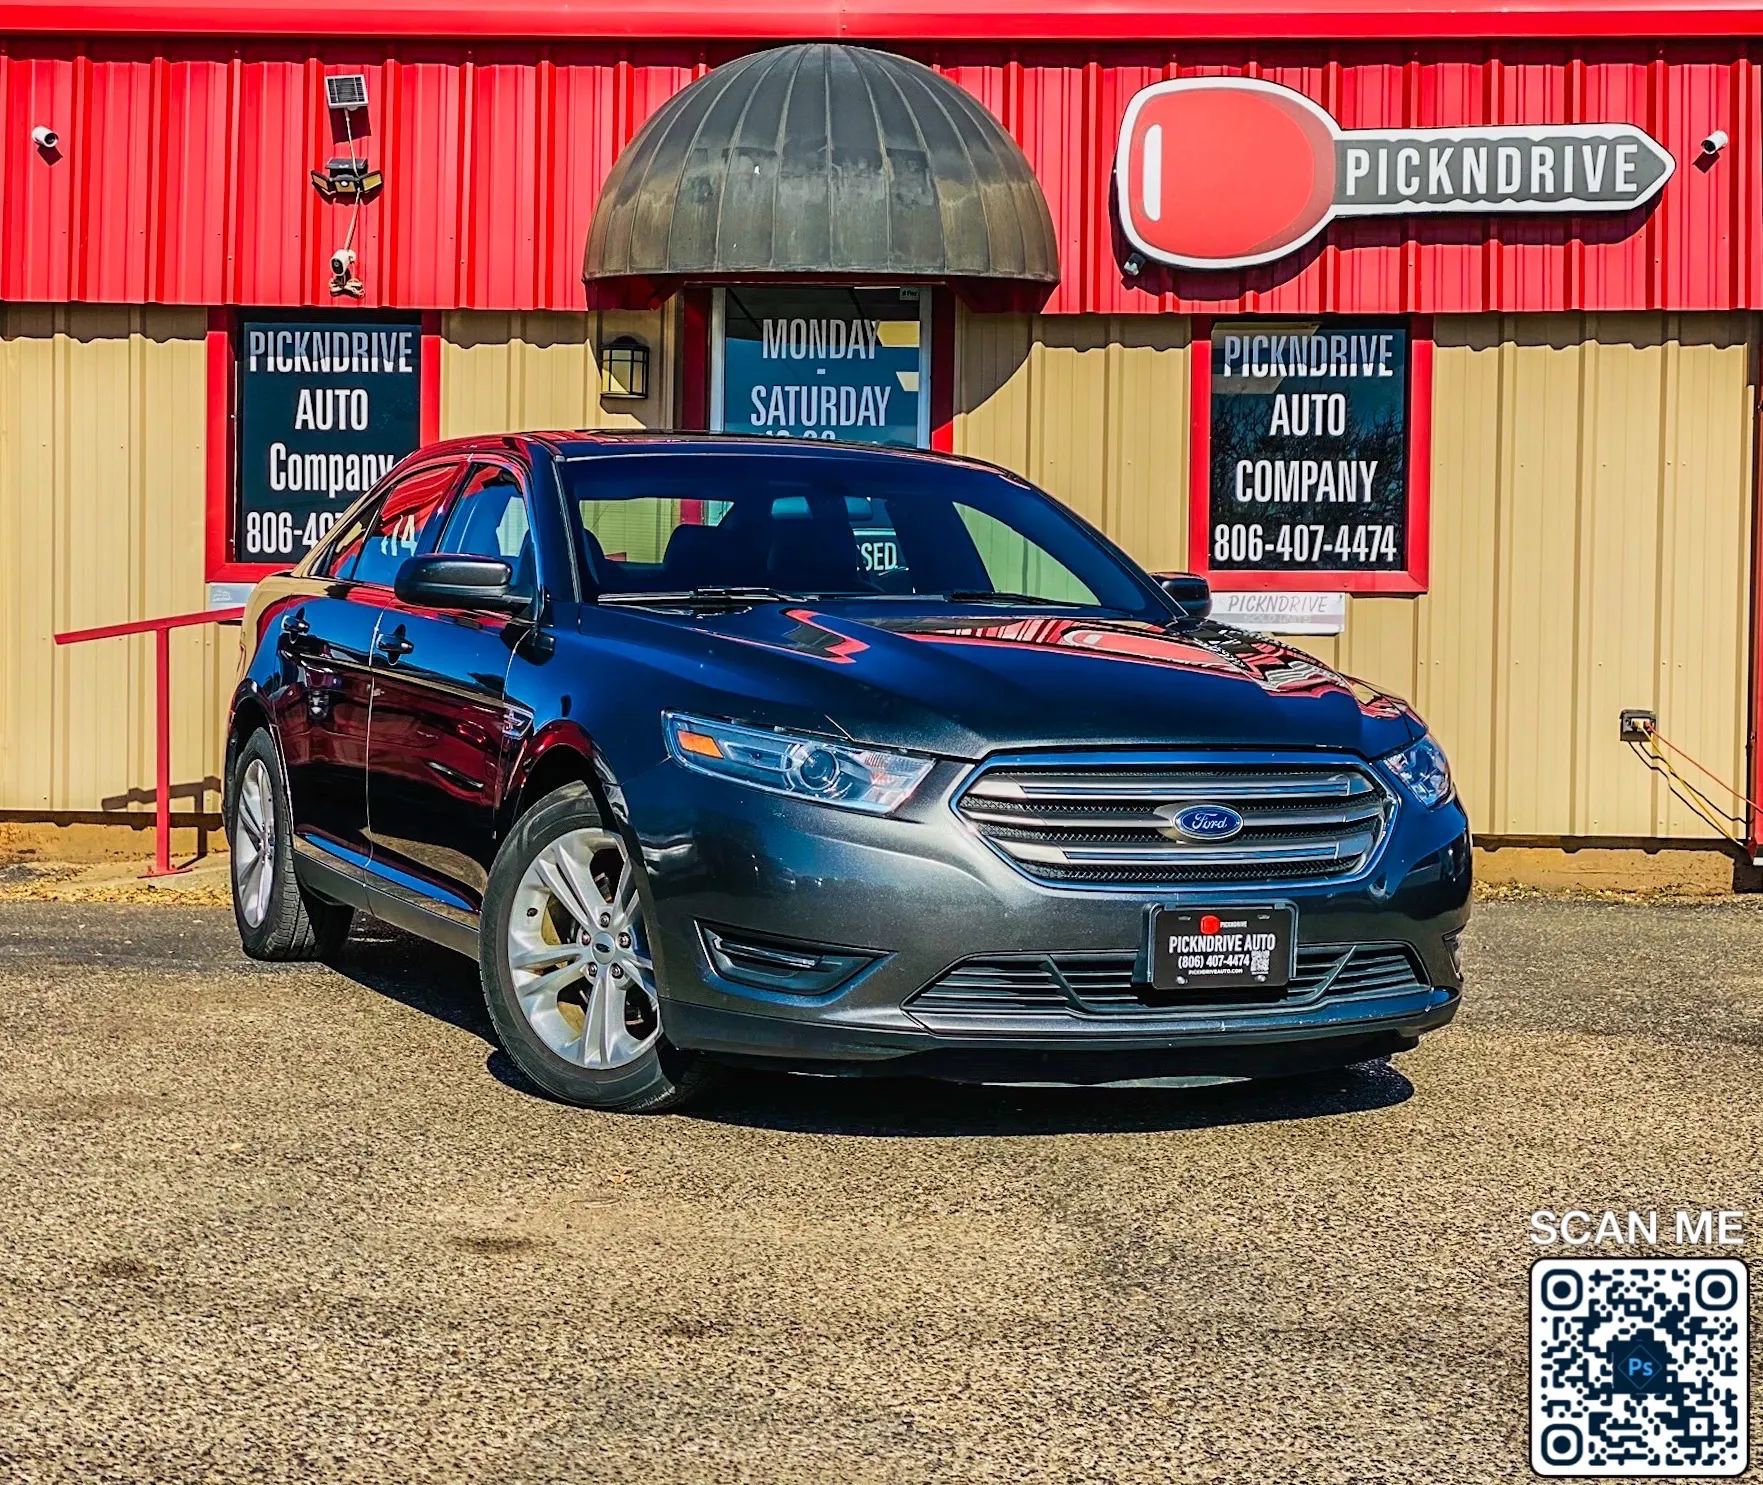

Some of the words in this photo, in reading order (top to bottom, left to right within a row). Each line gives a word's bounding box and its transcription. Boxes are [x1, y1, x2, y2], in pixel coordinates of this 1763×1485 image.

[1345, 143, 1639, 197] PICKNDRIVE
[249, 331, 413, 373] PICKNDRIVE
[762, 319, 881, 360] MONDAY
[1223, 335, 1394, 378] PICKNDRIVE
[294, 389, 369, 431] AUTO
[750, 385, 892, 427] SATURDAY
[1269, 393, 1347, 437] AUTO
[1236, 459, 1379, 503] COMPANY
[856, 542, 897, 571] SED
[1214, 523, 1398, 563] 806-407-4474
[1228, 595, 1328, 613] PICKNDRIVE
[1191, 812, 1228, 830] Ford
[1168, 934, 1243, 954] PICKNDRIVE
[1243, 933, 1276, 951] AUTO
[1178, 955, 1204, 969] (806)
[1206, 954, 1250, 968] 407-4474
